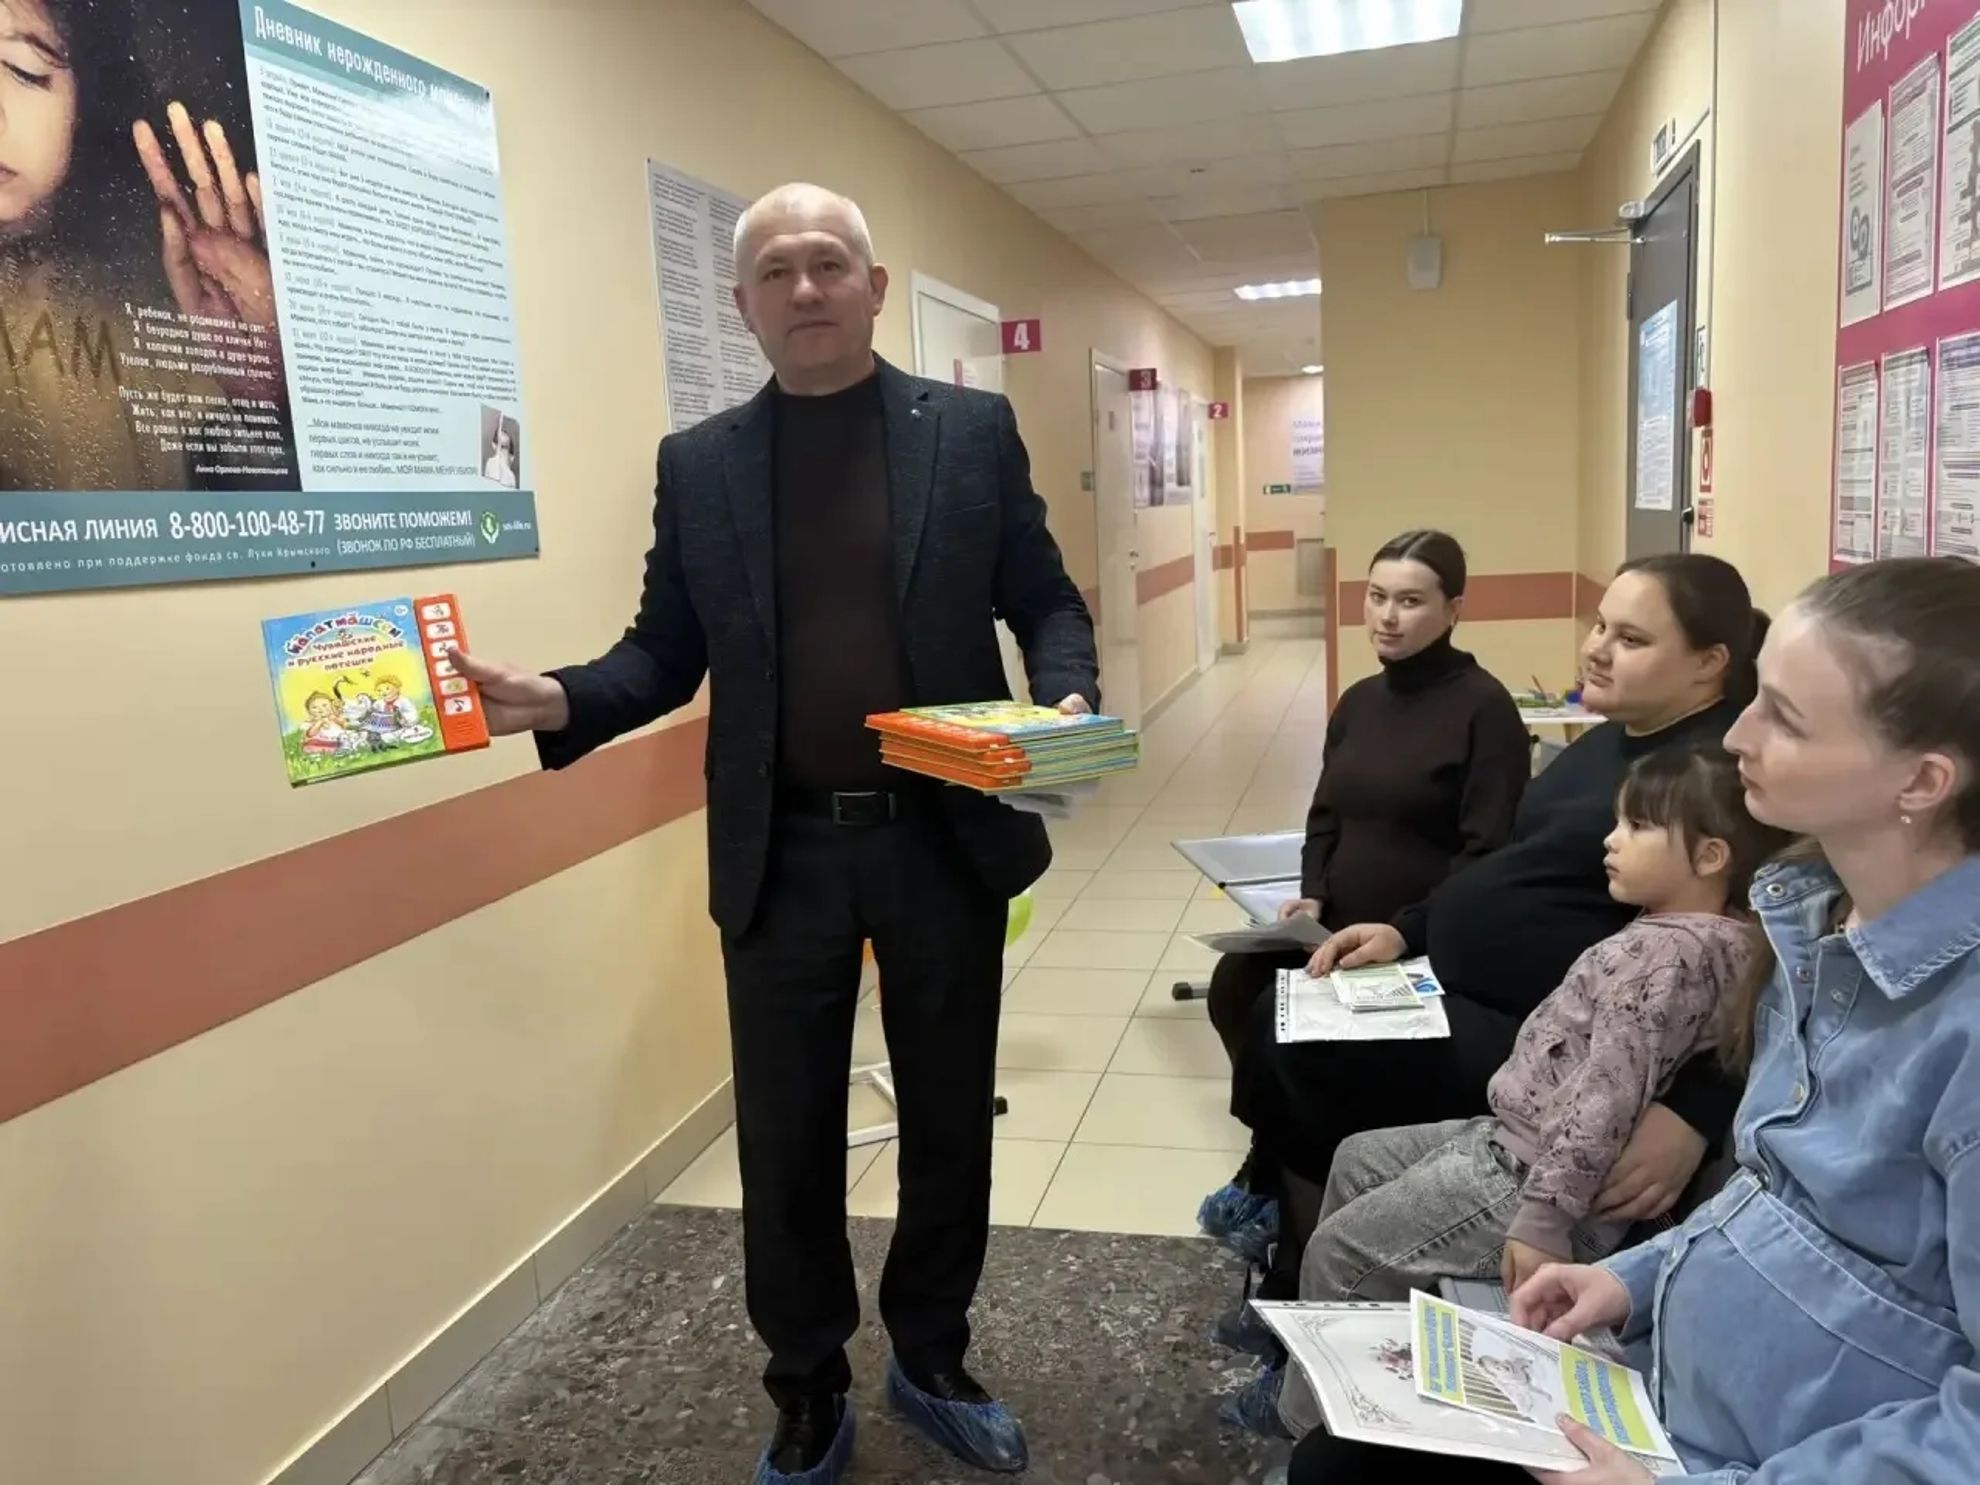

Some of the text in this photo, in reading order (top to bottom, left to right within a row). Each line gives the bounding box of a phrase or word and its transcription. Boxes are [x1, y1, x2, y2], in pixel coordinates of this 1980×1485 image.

[1857, 0, 1926, 72] Инфор
[254, 6, 426, 97] Дневник нерожденного
[1014, 322, 1030, 350] 4
[119, 385, 143, 401] Пусть
[161, 389, 185, 403] будет
[1213, 403, 1222, 418] 2
[84, 518, 158, 541] ЛИНИЯ
[169, 509, 326, 540] 8-800-100-48-77
[334, 513, 396, 531] ЗВОНИТЕ
[399, 510, 473, 528] ПОМОЖЕМ!
[401, 537, 413, 550] РФ
[416, 532, 476, 549] БЕСПЛАТНЫЙ)
[78, 557, 102, 570] при
[109, 553, 181, 568] поддержке
[185, 550, 222, 564] фонда
[248, 547, 273, 560] Луки
[277, 546, 331, 558] Крымского
[297, 651, 344, 667] русские
[347, 640, 404, 657] народные
[324, 657, 374, 671] потешки
